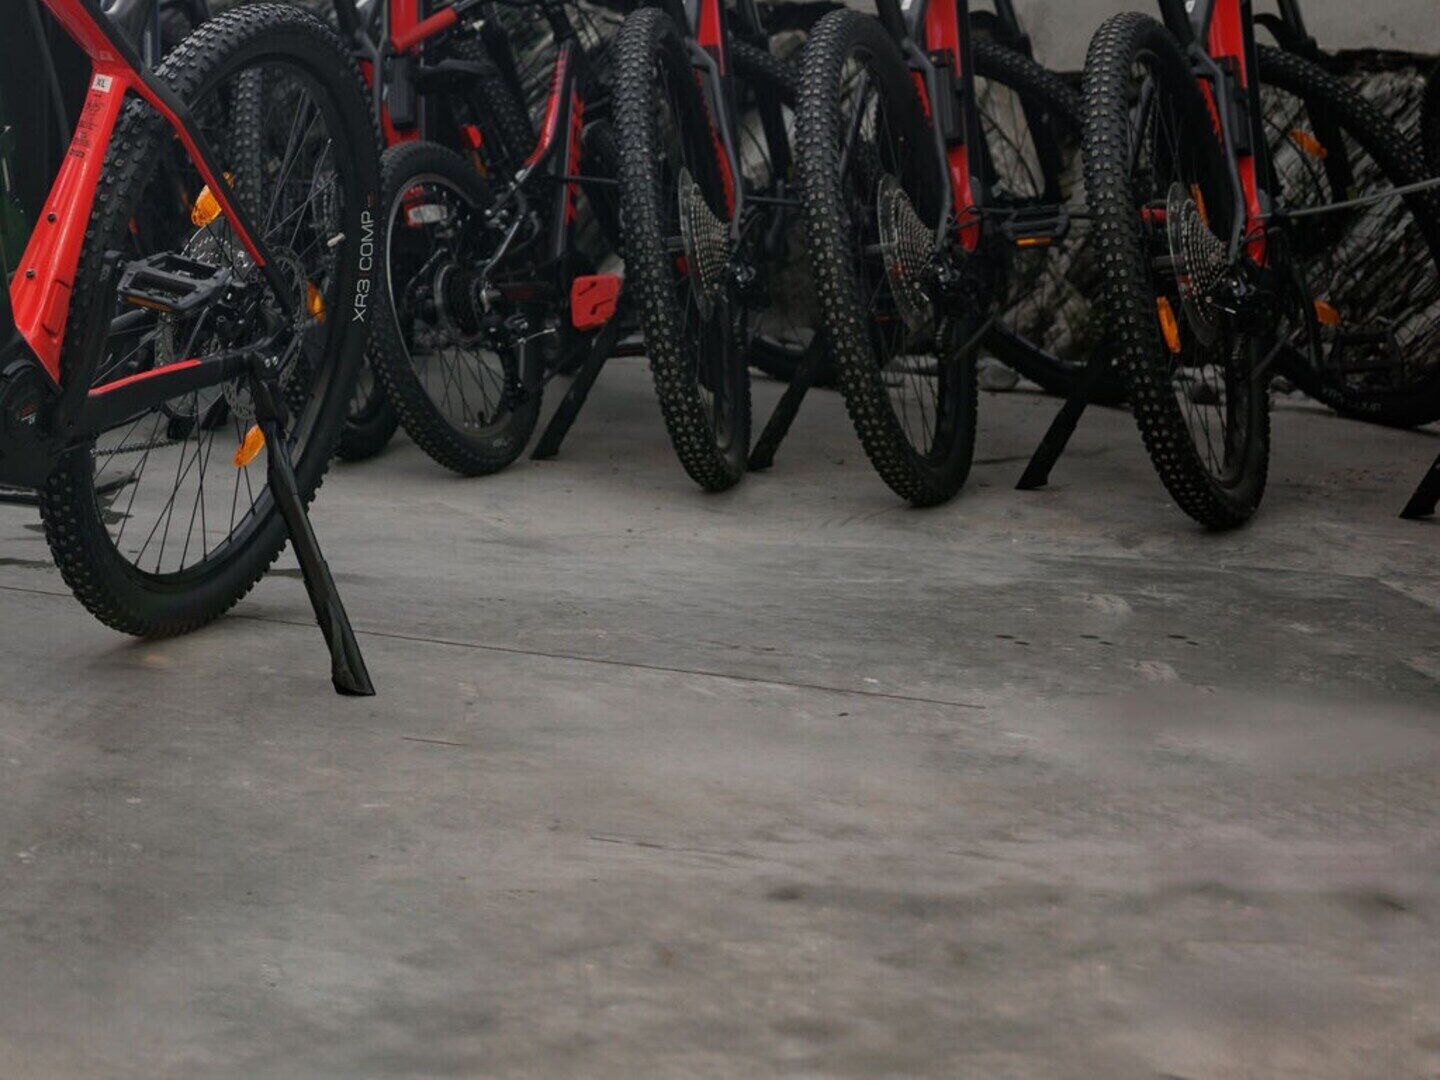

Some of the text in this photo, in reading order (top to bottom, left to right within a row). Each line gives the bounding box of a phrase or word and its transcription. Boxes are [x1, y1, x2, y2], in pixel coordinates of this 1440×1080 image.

[96, 77, 107, 88] XL
[352, 210, 374, 322] XR3 COMP
